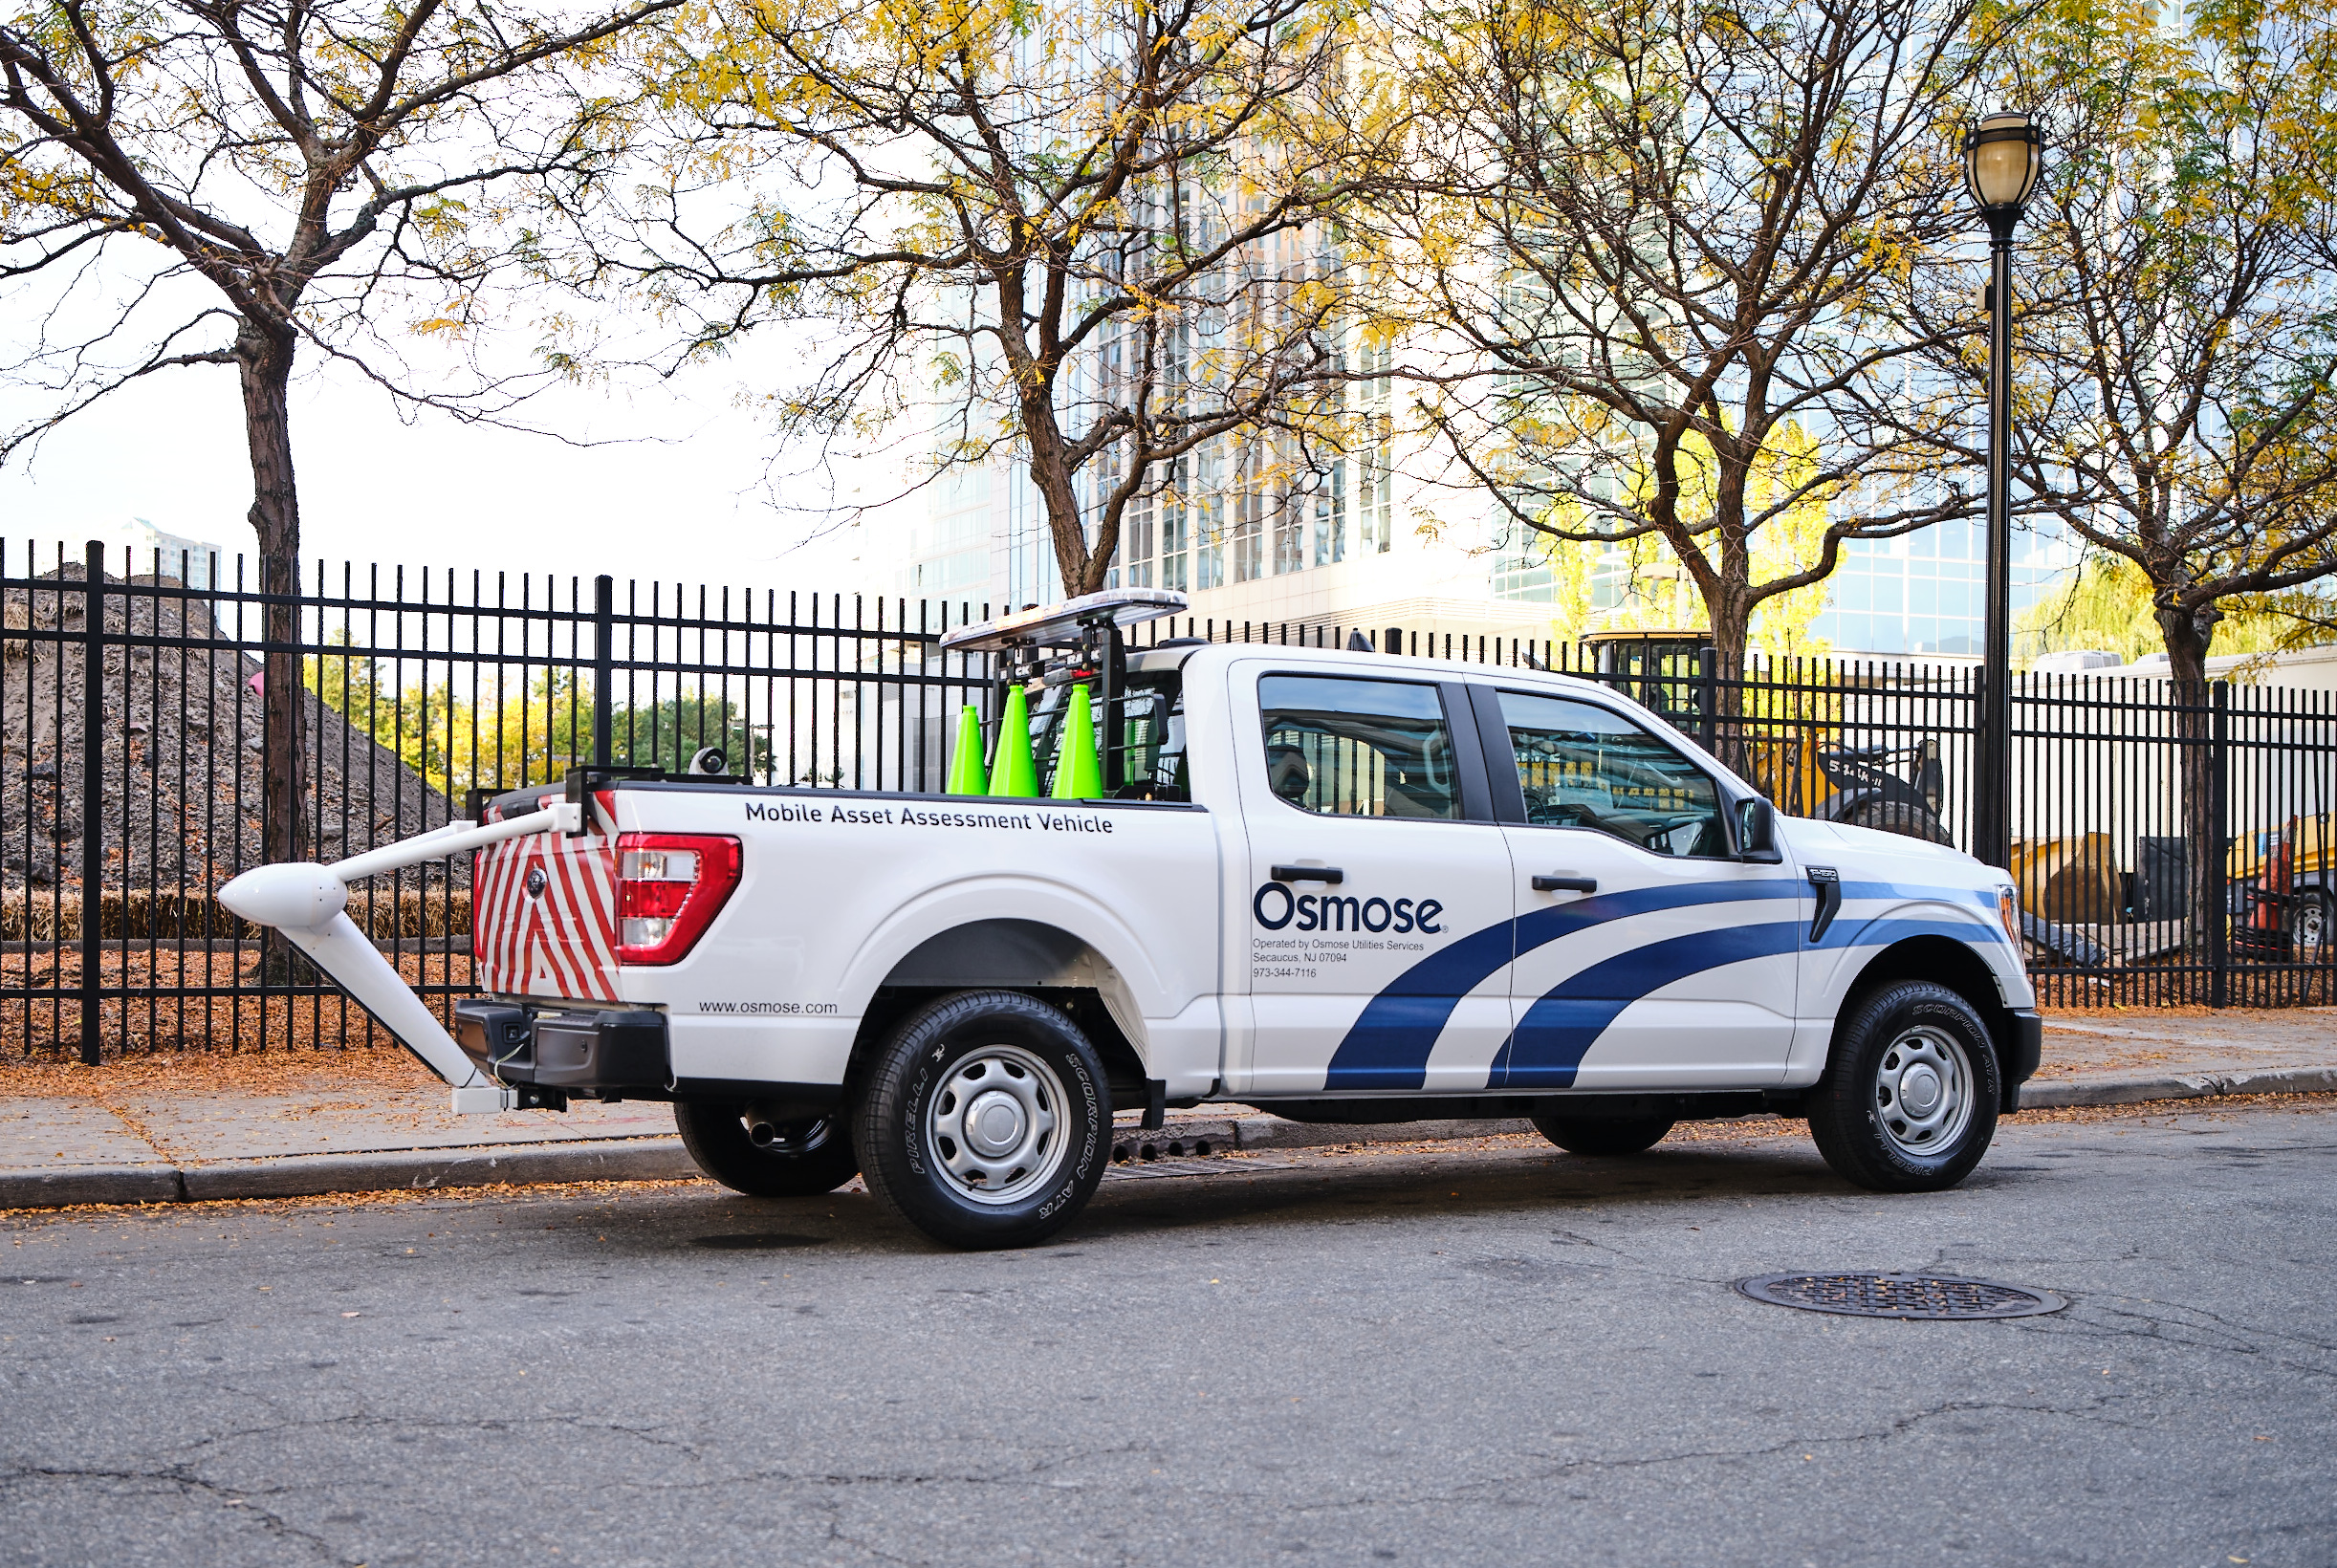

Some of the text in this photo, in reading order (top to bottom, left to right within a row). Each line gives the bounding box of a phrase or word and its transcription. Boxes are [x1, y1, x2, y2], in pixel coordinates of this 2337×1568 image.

[1066, 649, 1101, 665] RAK
[744, 802, 1114, 834] Mobile Asset Assessment Vehicle
[1253, 882, 1443, 934] Osmose
[1252, 937, 1425, 951] Operated by Osmose Utilities Services
[1253, 951, 1347, 964] Secaucus, NJ 07094
[1253, 967, 1317, 978] 973-344-7116
[698, 1001, 838, 1014] www.osmose.com
[1911, 1003, 1986, 1048] SCORPION
[905, 1067, 928, 1174] PIRELLI
[1038, 1053, 1099, 1220] SCORPION ATR
[1874, 1133, 1935, 1176] PIRELLI
